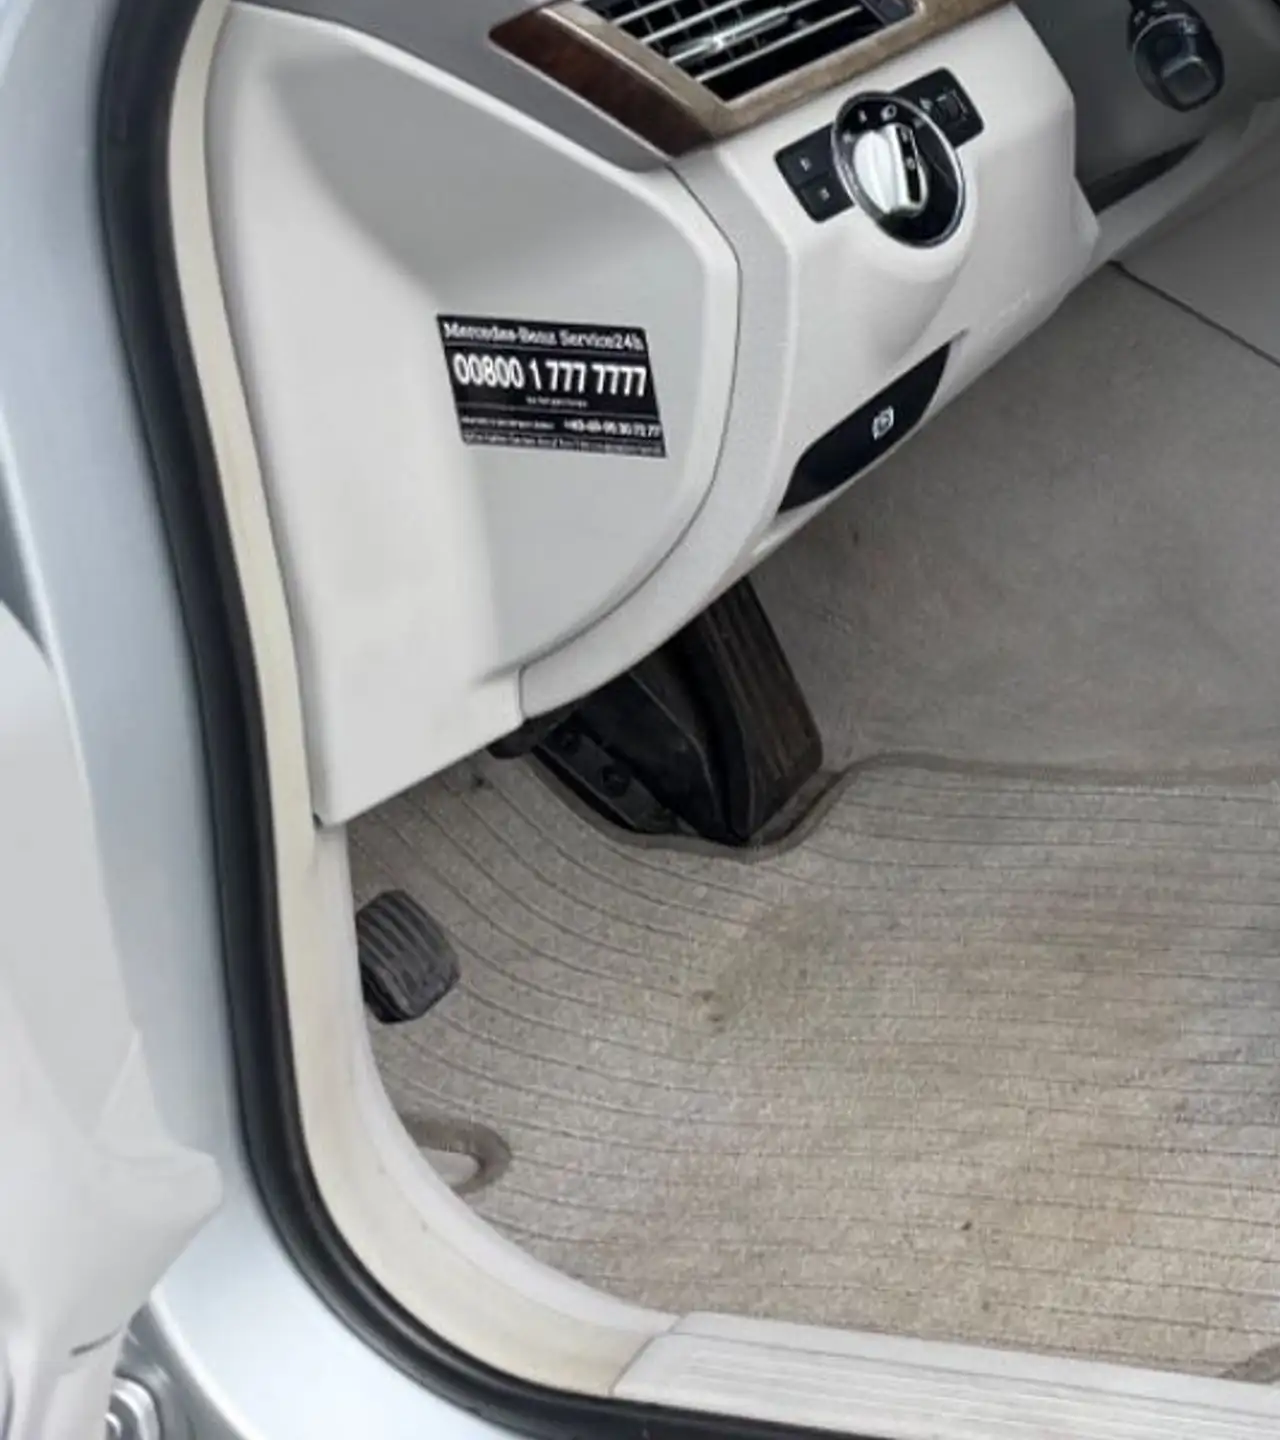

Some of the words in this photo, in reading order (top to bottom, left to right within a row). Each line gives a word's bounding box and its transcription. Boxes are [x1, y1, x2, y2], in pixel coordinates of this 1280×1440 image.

[453, 353, 524, 389] 00800
[529, 358, 542, 390] 1
[545, 362, 586, 392] 777
[591, 364, 647, 397] 7777
